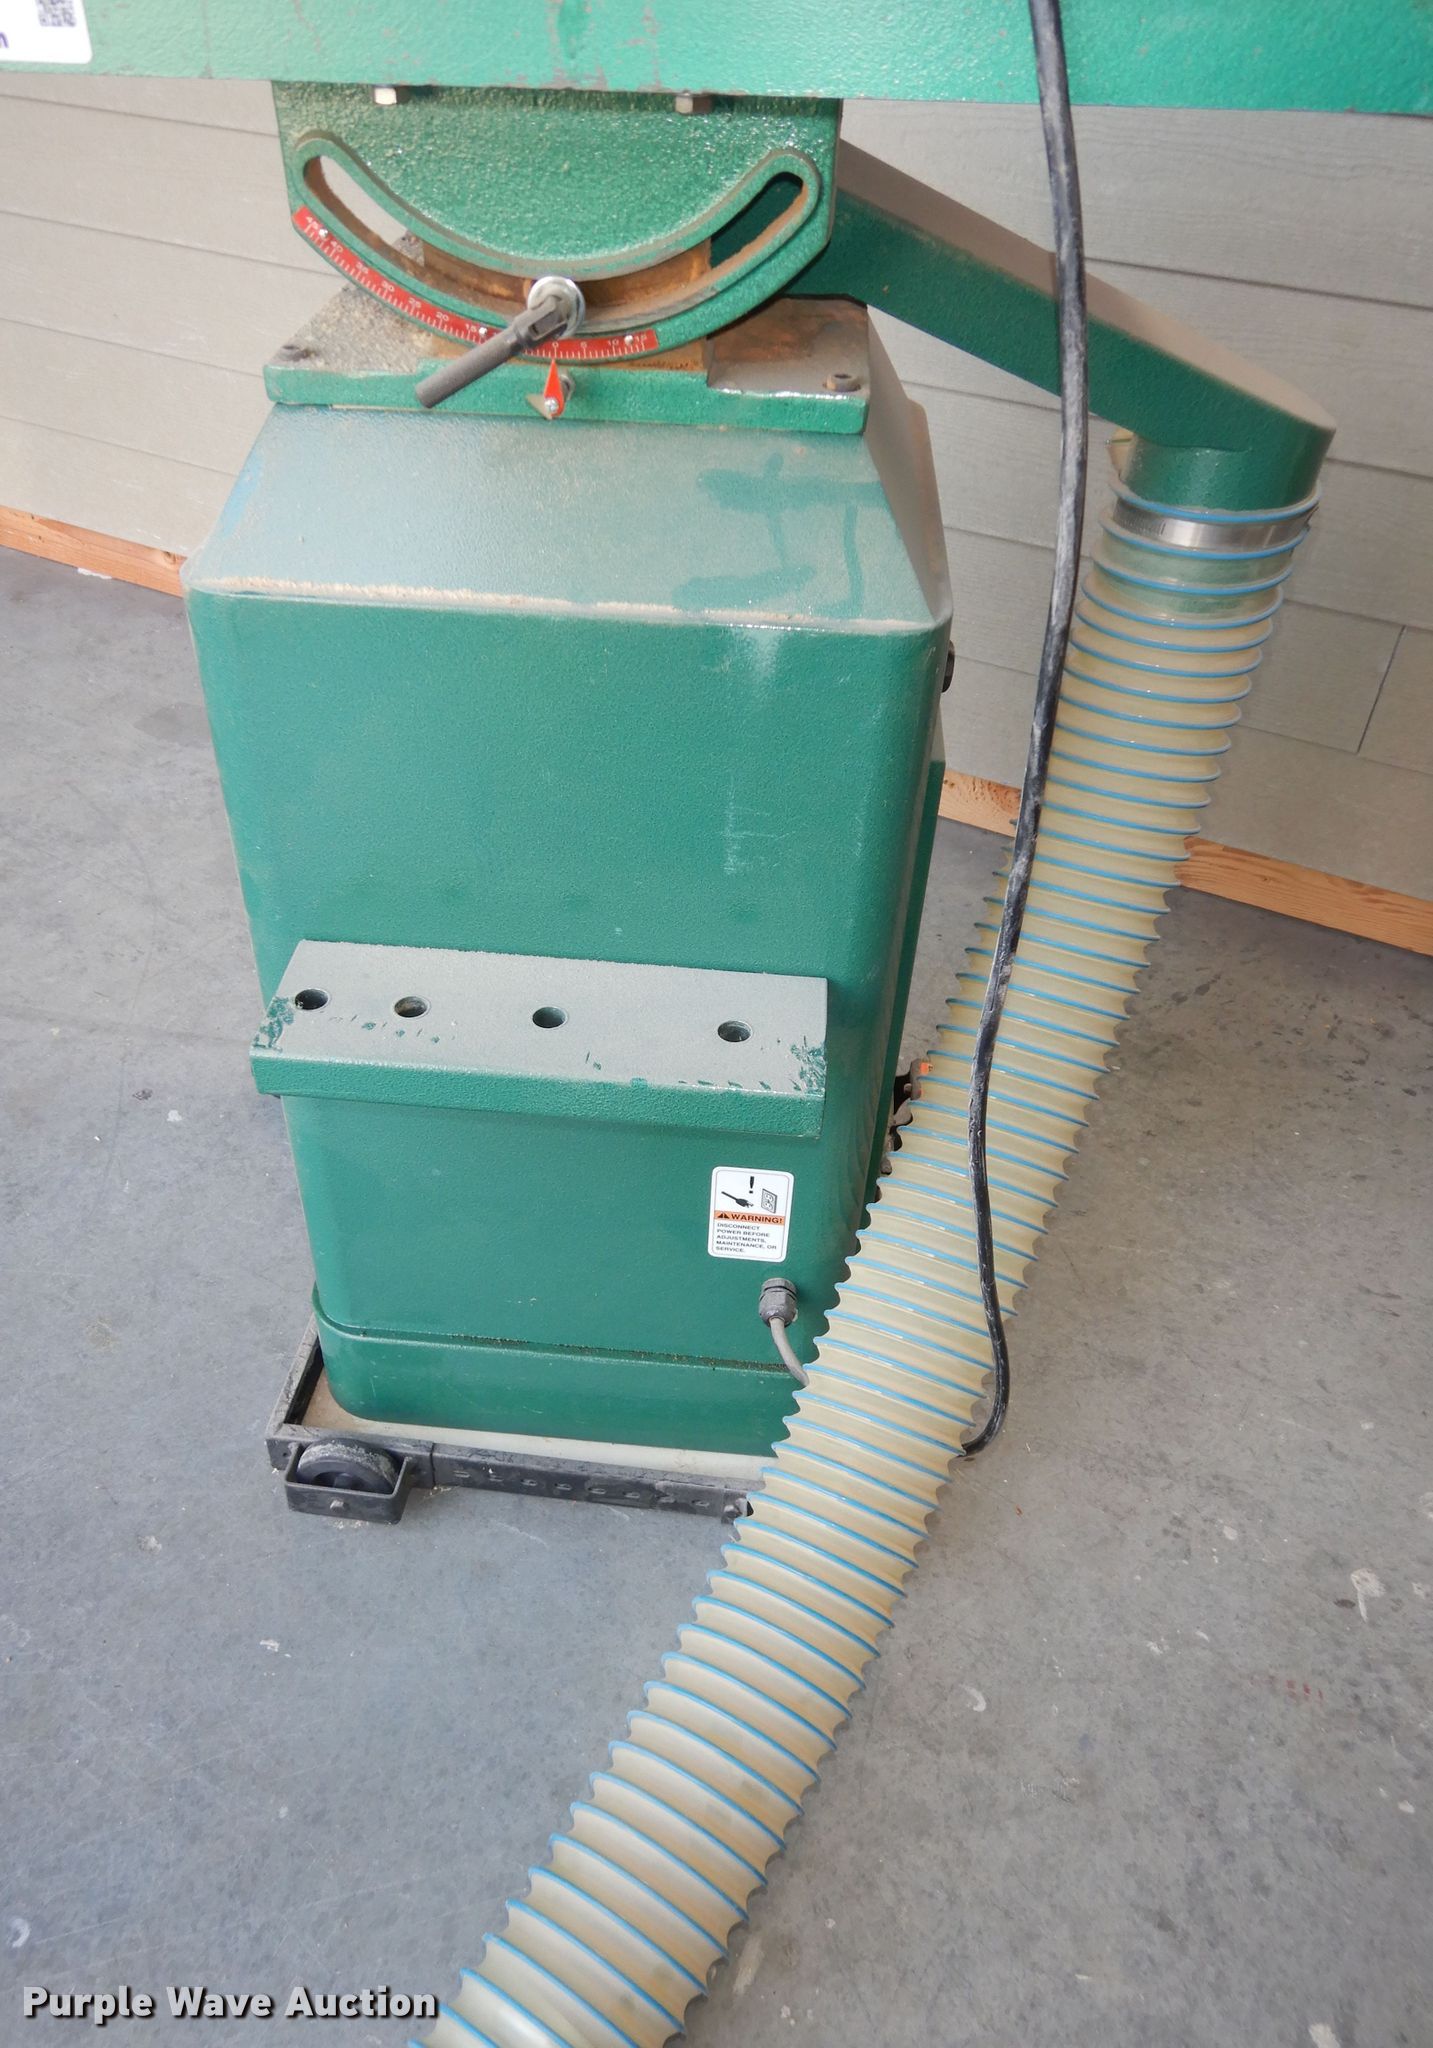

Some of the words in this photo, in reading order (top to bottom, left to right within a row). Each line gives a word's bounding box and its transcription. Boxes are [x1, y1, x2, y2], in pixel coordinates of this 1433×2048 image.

[330, 241, 344, 252] 40
[436, 311, 450, 321] 20
[465, 323, 477, 333] 15
[607, 339, 620, 347] 10
[731, 1213, 783, 1224] WARNING!
